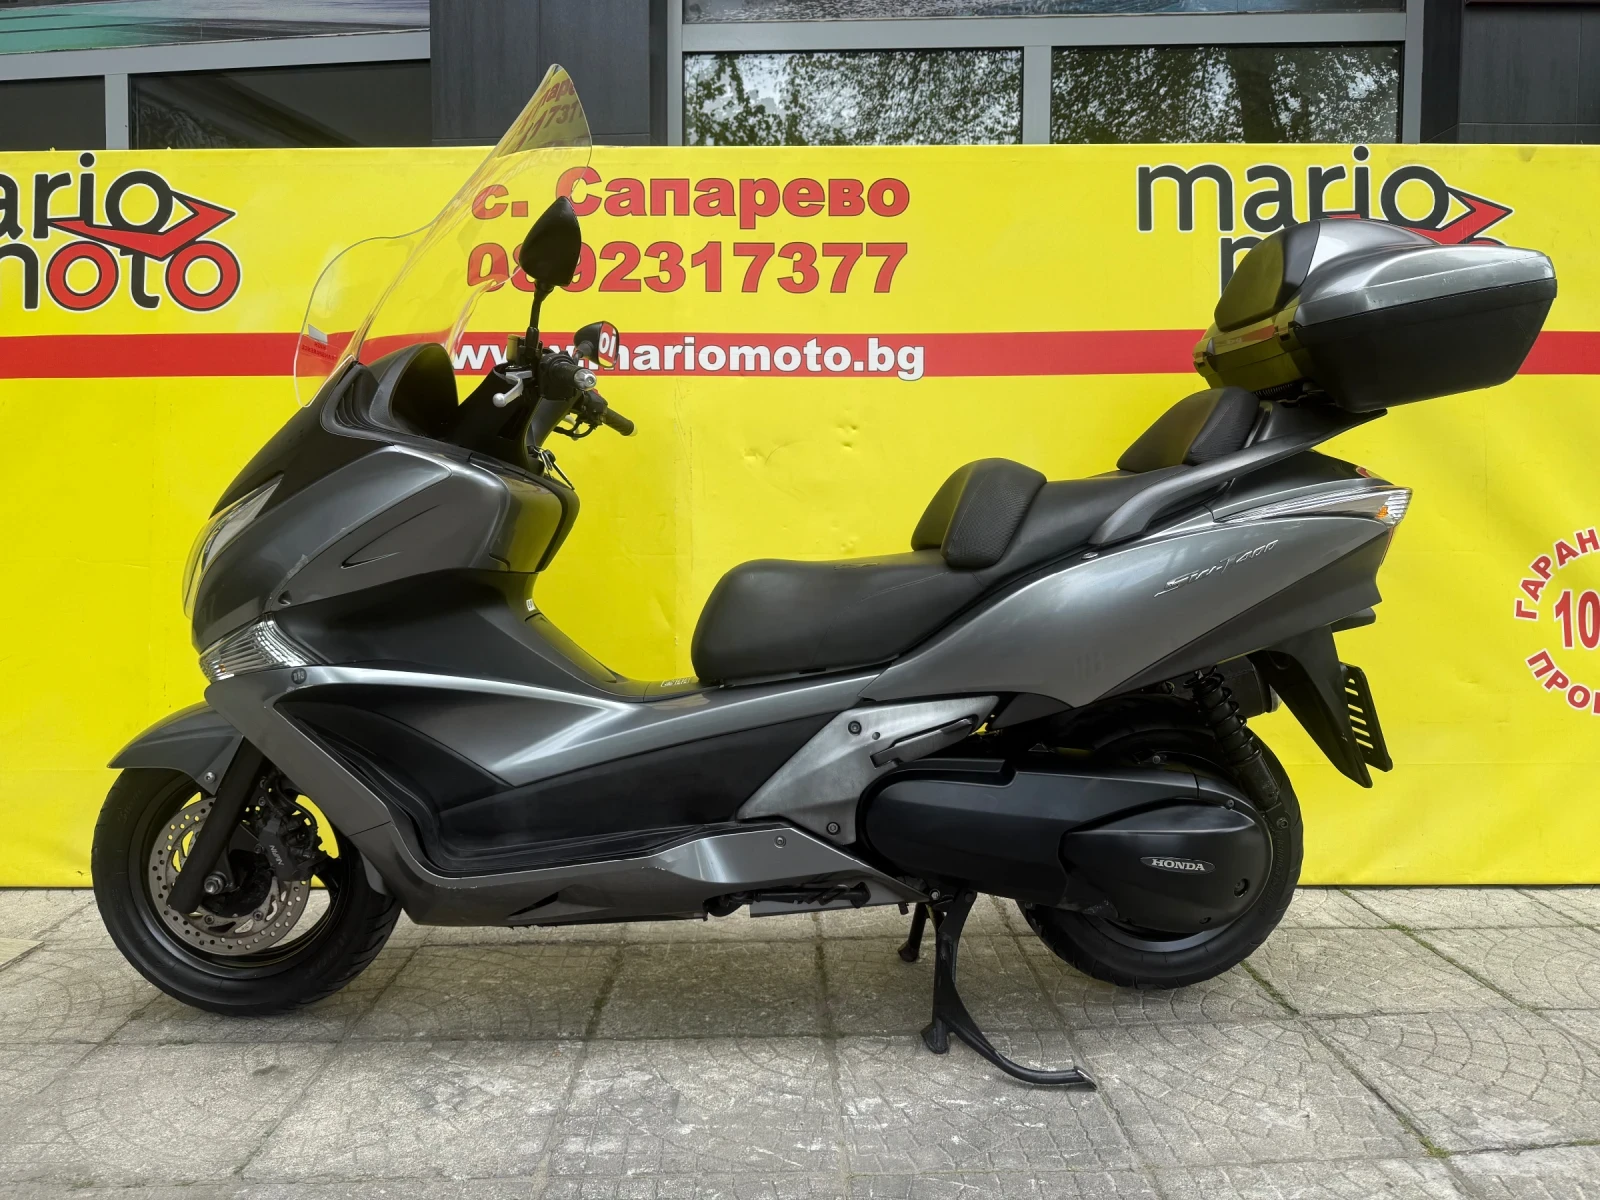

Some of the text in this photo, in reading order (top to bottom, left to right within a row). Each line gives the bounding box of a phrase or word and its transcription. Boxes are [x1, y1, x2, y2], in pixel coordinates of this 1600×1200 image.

[555, 166, 910, 230] Сапарево
[1137, 144, 1450, 233] mario
[466, 240, 908, 293] 02317377
[1525, 649, 1600, 715] ПРО
[1151, 858, 1206, 872] HONDA
